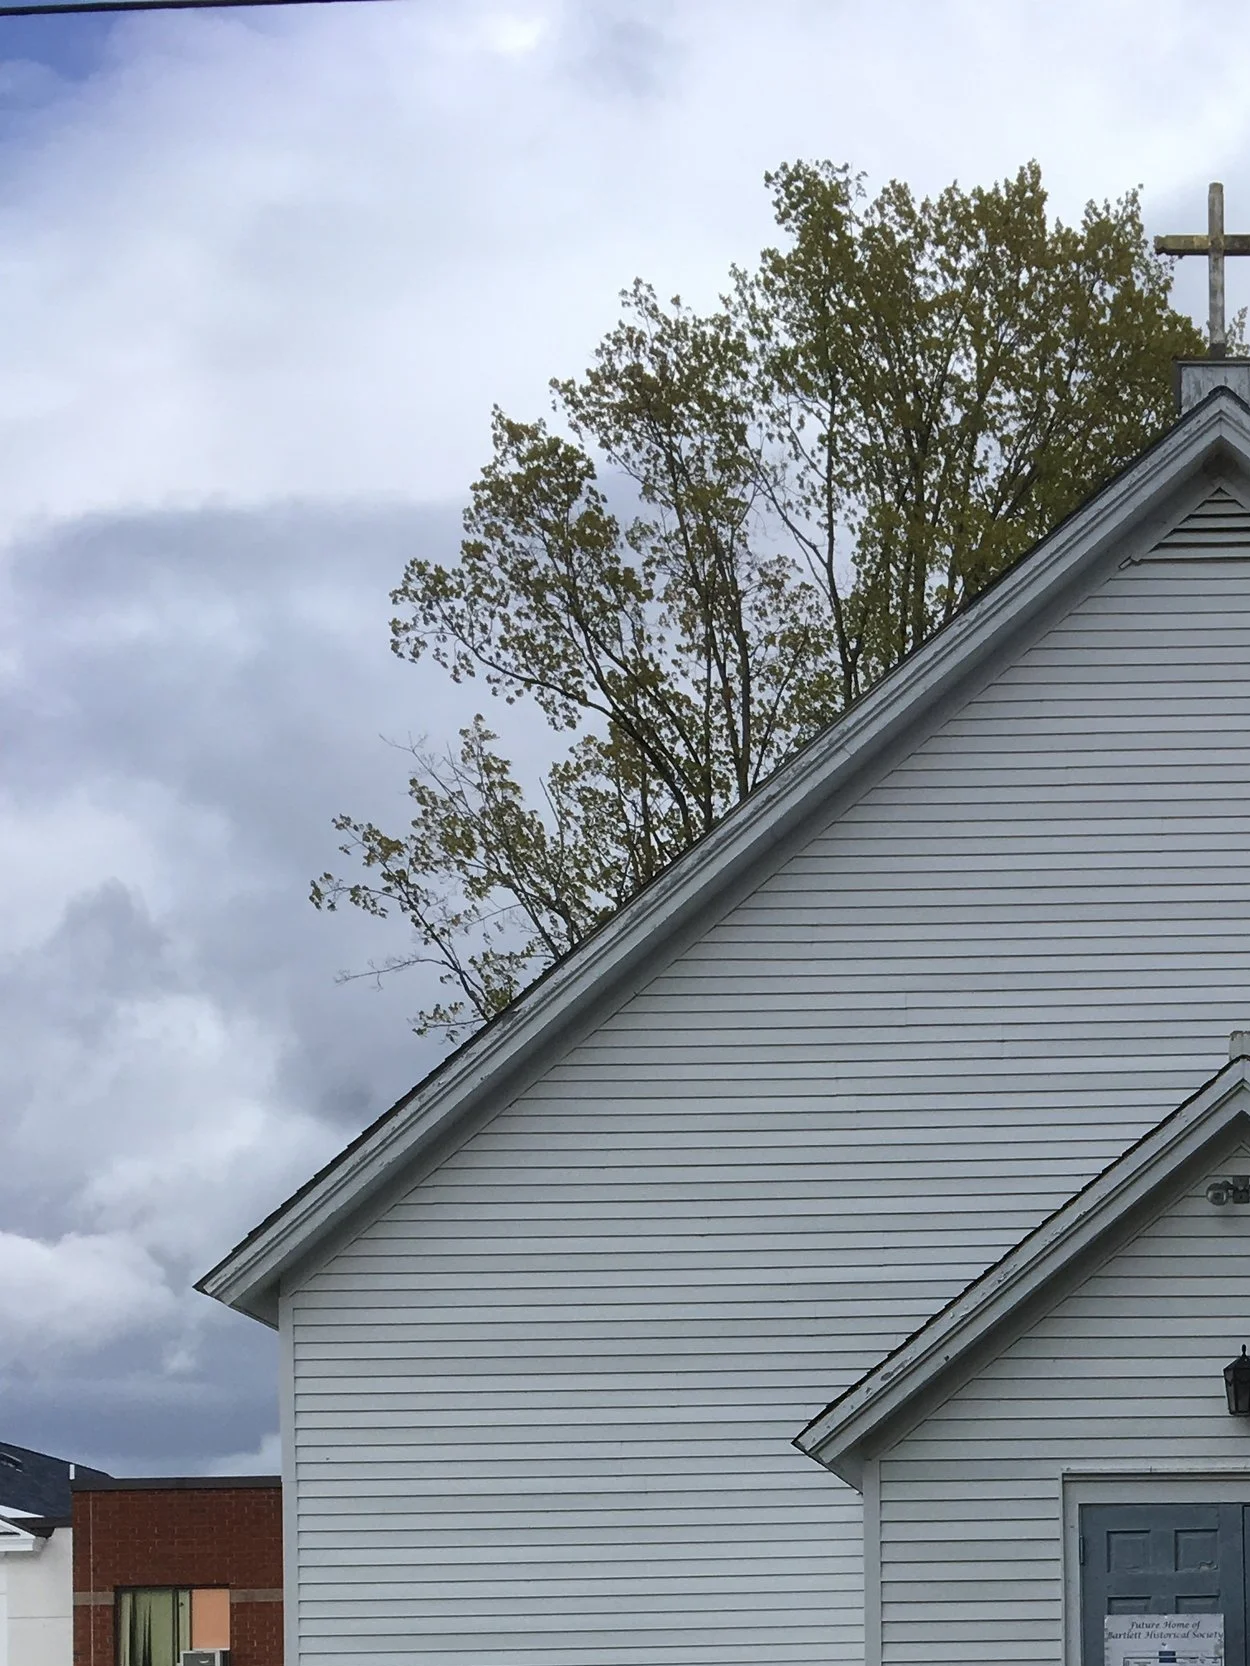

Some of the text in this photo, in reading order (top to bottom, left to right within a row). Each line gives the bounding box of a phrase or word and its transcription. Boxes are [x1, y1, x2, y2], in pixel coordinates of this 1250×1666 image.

[1130, 1620, 1201, 1632] Future Home of
[1108, 1631, 1224, 1640] Bartlett Historical Society
